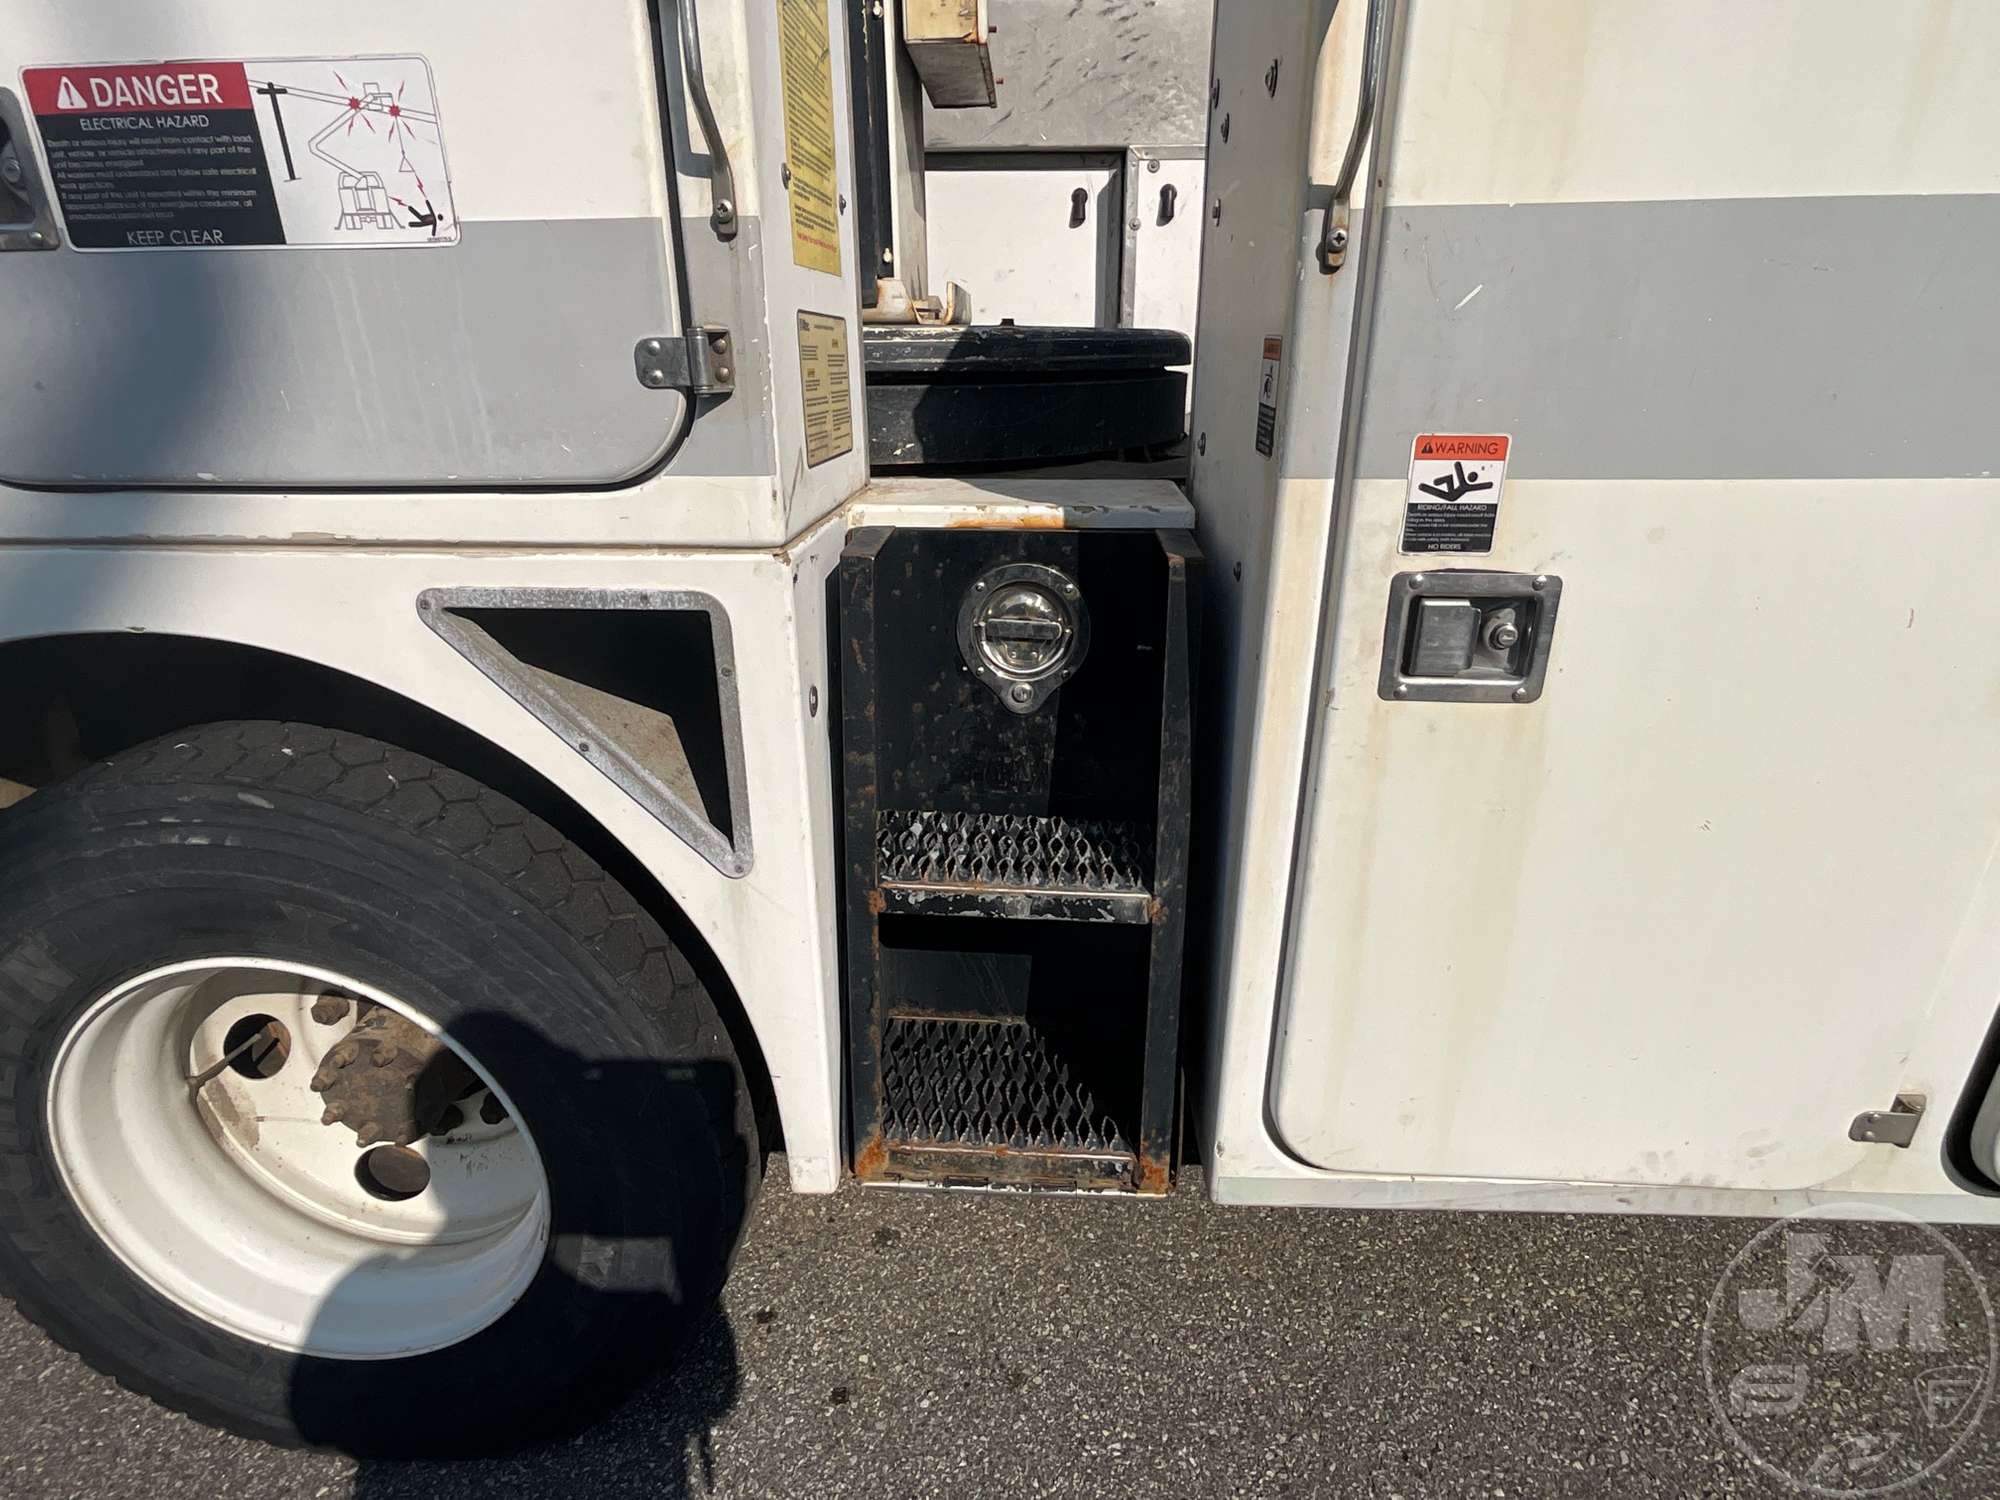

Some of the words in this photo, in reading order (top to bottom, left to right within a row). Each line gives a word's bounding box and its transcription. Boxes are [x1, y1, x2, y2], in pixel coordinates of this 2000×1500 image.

[89, 73, 224, 108] DANGER
[79, 115, 154, 132] ELECTRICAL
[156, 114, 210, 129] HAZARD
[126, 230, 165, 246] KEEP
[169, 228, 225, 244] CLEAR
[1434, 442, 1499, 455] WARNING
[1459, 504, 1488, 512] HAZARD
